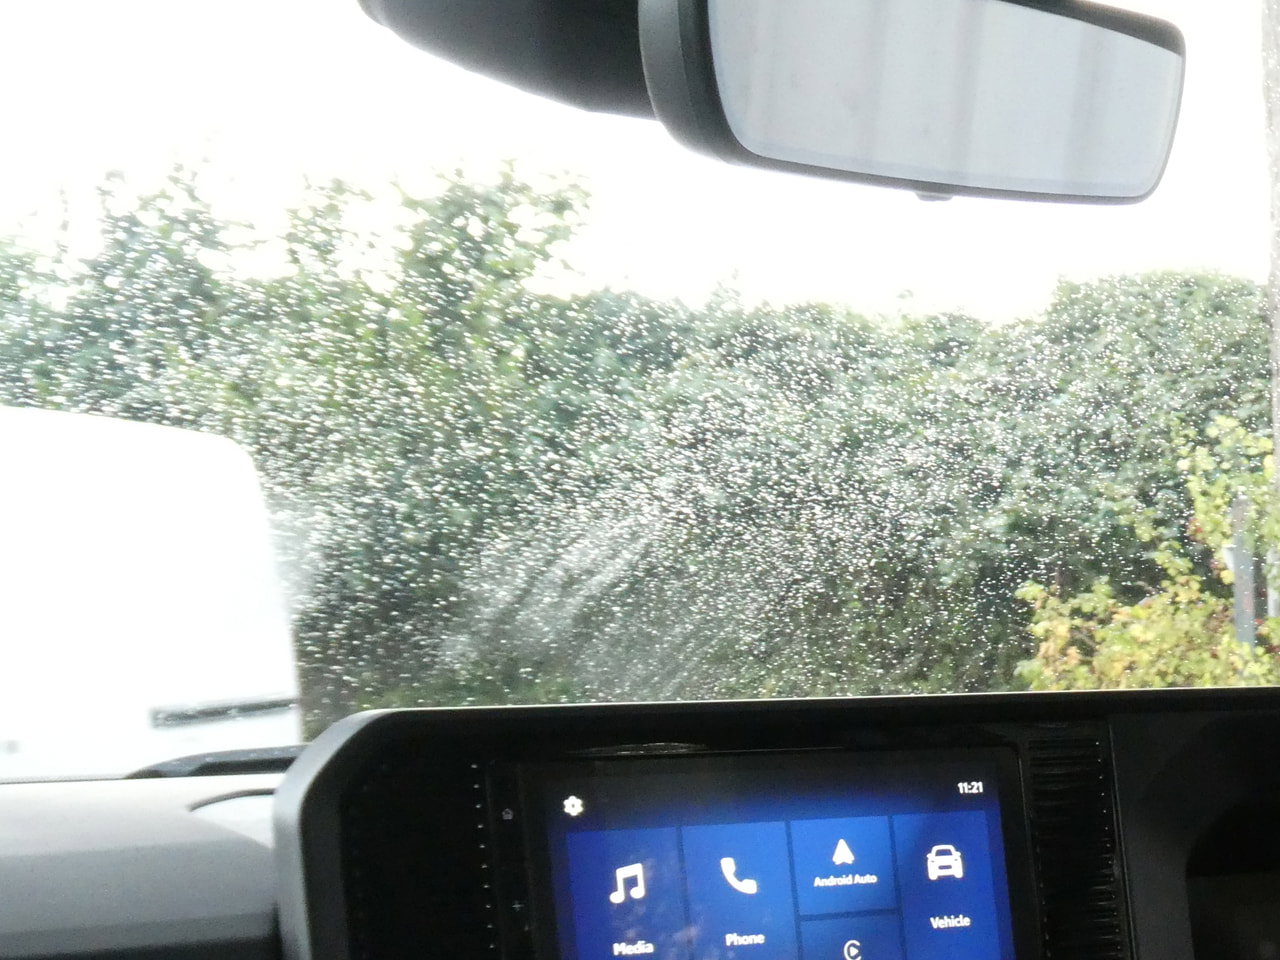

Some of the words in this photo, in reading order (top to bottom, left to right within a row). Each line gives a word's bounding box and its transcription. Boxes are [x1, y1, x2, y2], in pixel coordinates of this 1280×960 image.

[957, 781, 983, 794] 11:21
[813, 875, 852, 887] Android
[854, 874, 878, 884] Auto
[930, 914, 971, 929] Vehicle
[725, 933, 765, 946] Phone
[613, 940, 654, 956] Media
